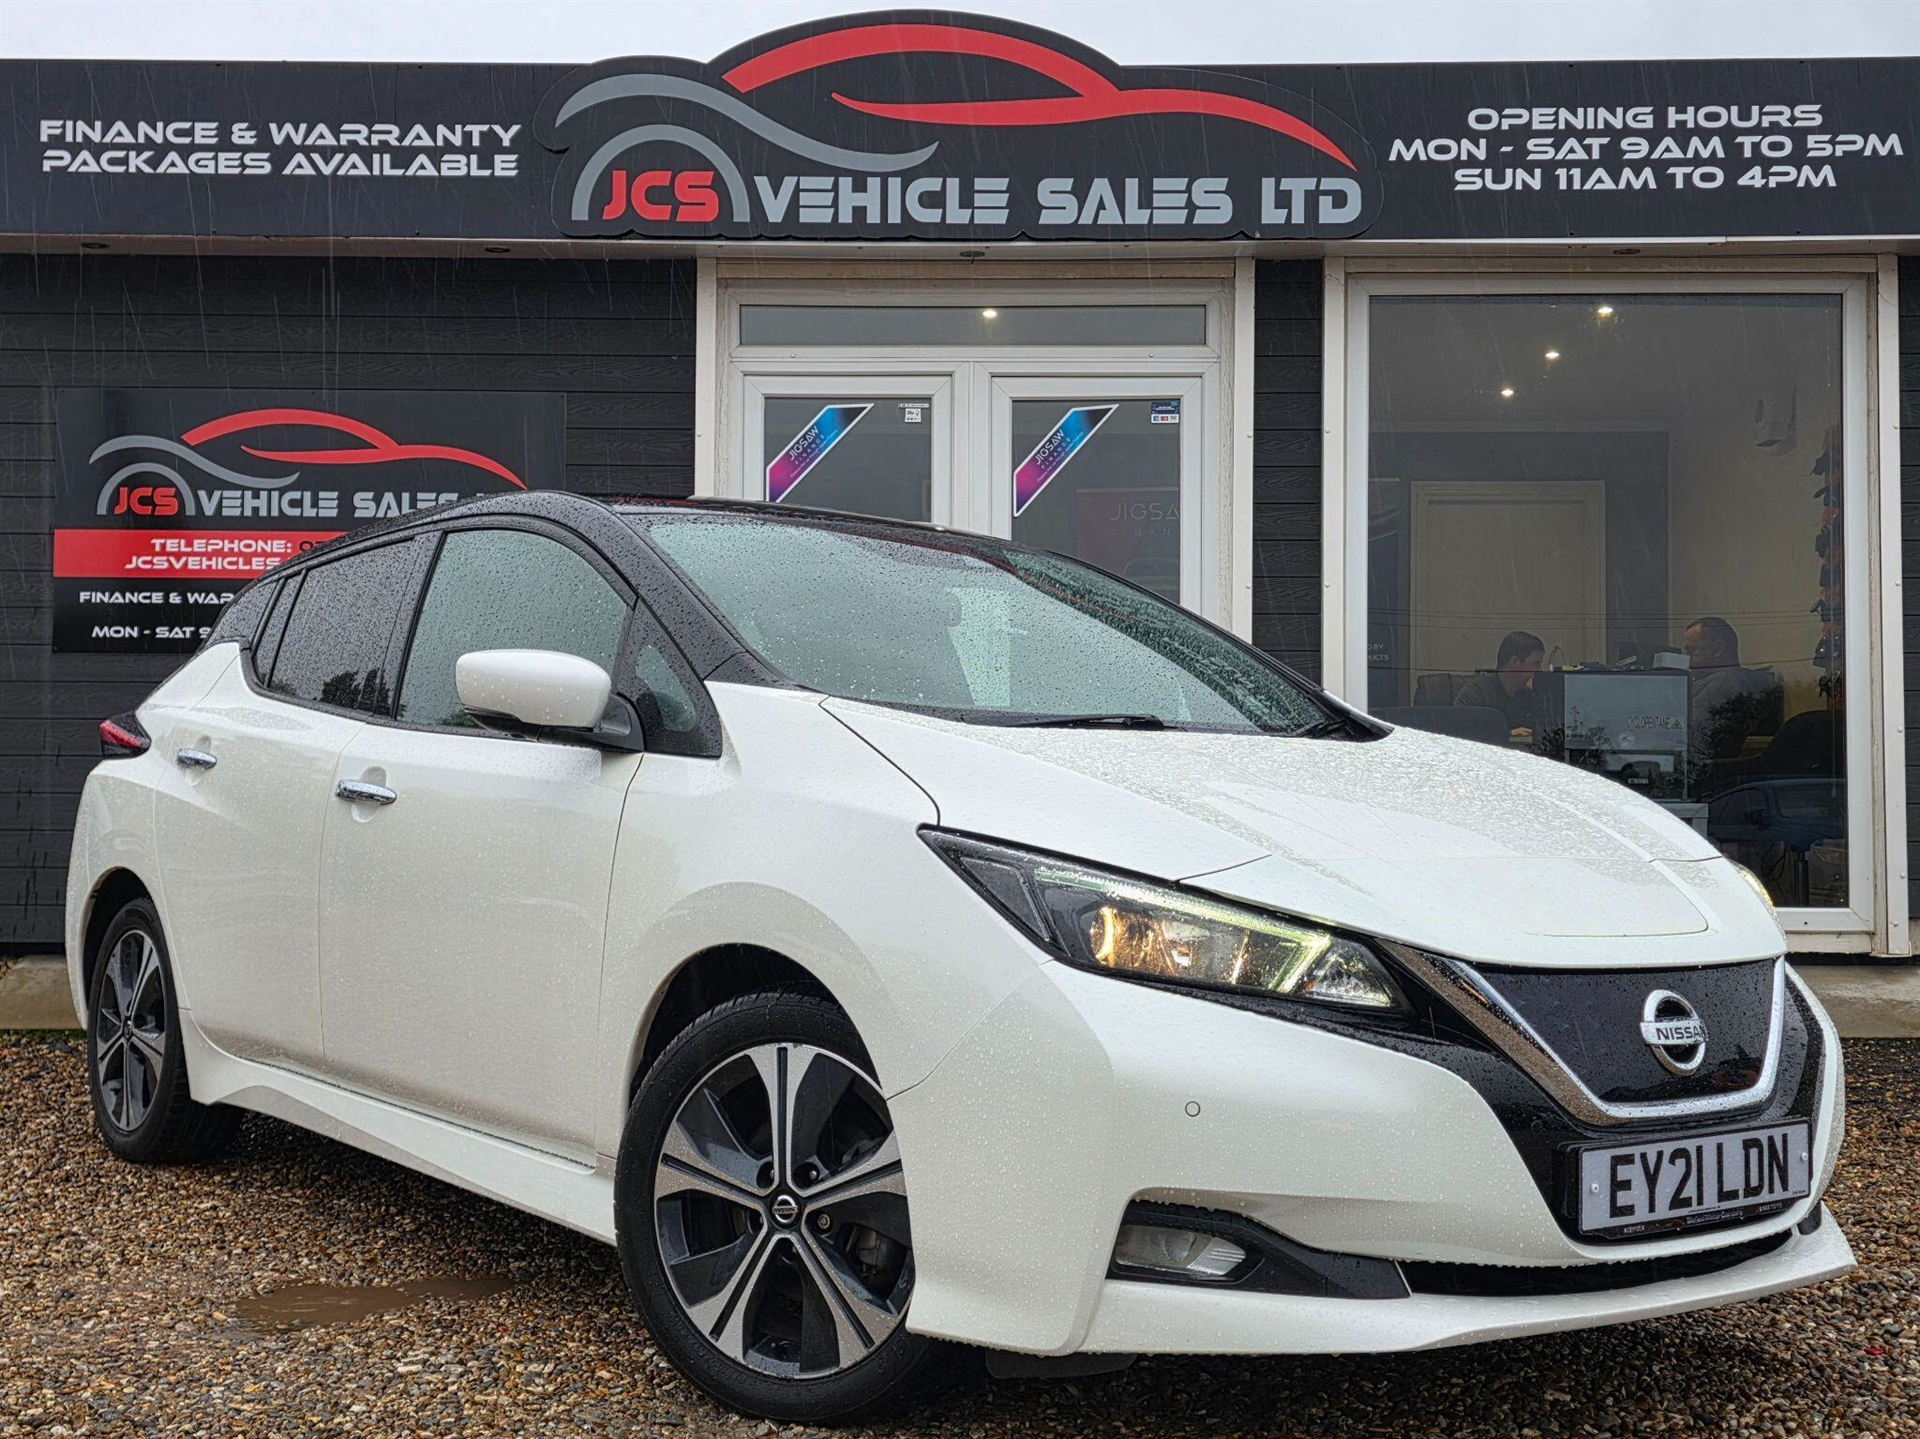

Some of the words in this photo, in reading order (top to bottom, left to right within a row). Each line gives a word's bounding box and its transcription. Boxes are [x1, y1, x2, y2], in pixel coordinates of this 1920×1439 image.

[1467, 106, 1654, 131] OPENING
[1667, 104, 1823, 129] HOURS
[39, 119, 219, 145] FINANCE
[231, 122, 257, 145] &
[268, 121, 522, 147] WARRANTY
[1388, 138, 1487, 162] MON
[1526, 137, 1611, 160] SAT
[1620, 135, 1725, 160] 9AM
[1734, 134, 1793, 158] TO
[1806, 133, 1904, 157] 5PM
[41, 149, 272, 175] PACKAGES
[281, 152, 519, 177] AVAILABLE
[1454, 167, 1542, 191] SUN
[1554, 166, 1657, 190] 11AM
[1666, 165, 1725, 189] TO
[1737, 164, 1837, 188] 4PM
[601, 170, 720, 223] JCS
[757, 175, 1010, 225] VEHICLE
[1037, 177, 1233, 225] SALES
[1261, 177, 1362, 225] LTD
[788, 425, 820, 461] JIGSAW
[1035, 429, 1065, 465] JIGSAW
[113, 486, 179, 516] JCS
[197, 489, 339, 518] VEHICLE
[151, 538, 292, 553] TELEPHONE:
[124, 555, 281, 570] JCSVEHICLES
[79, 591, 164, 604] FINANCE
[168, 592, 182, 604] &
[91, 625, 139, 638] MON
[155, 626, 195, 639] SAT
[1655, 1024, 1707, 1041] NISSAN
[1609, 1144, 1704, 1219] EY21
[1716, 1132, 1790, 1203] LDN
